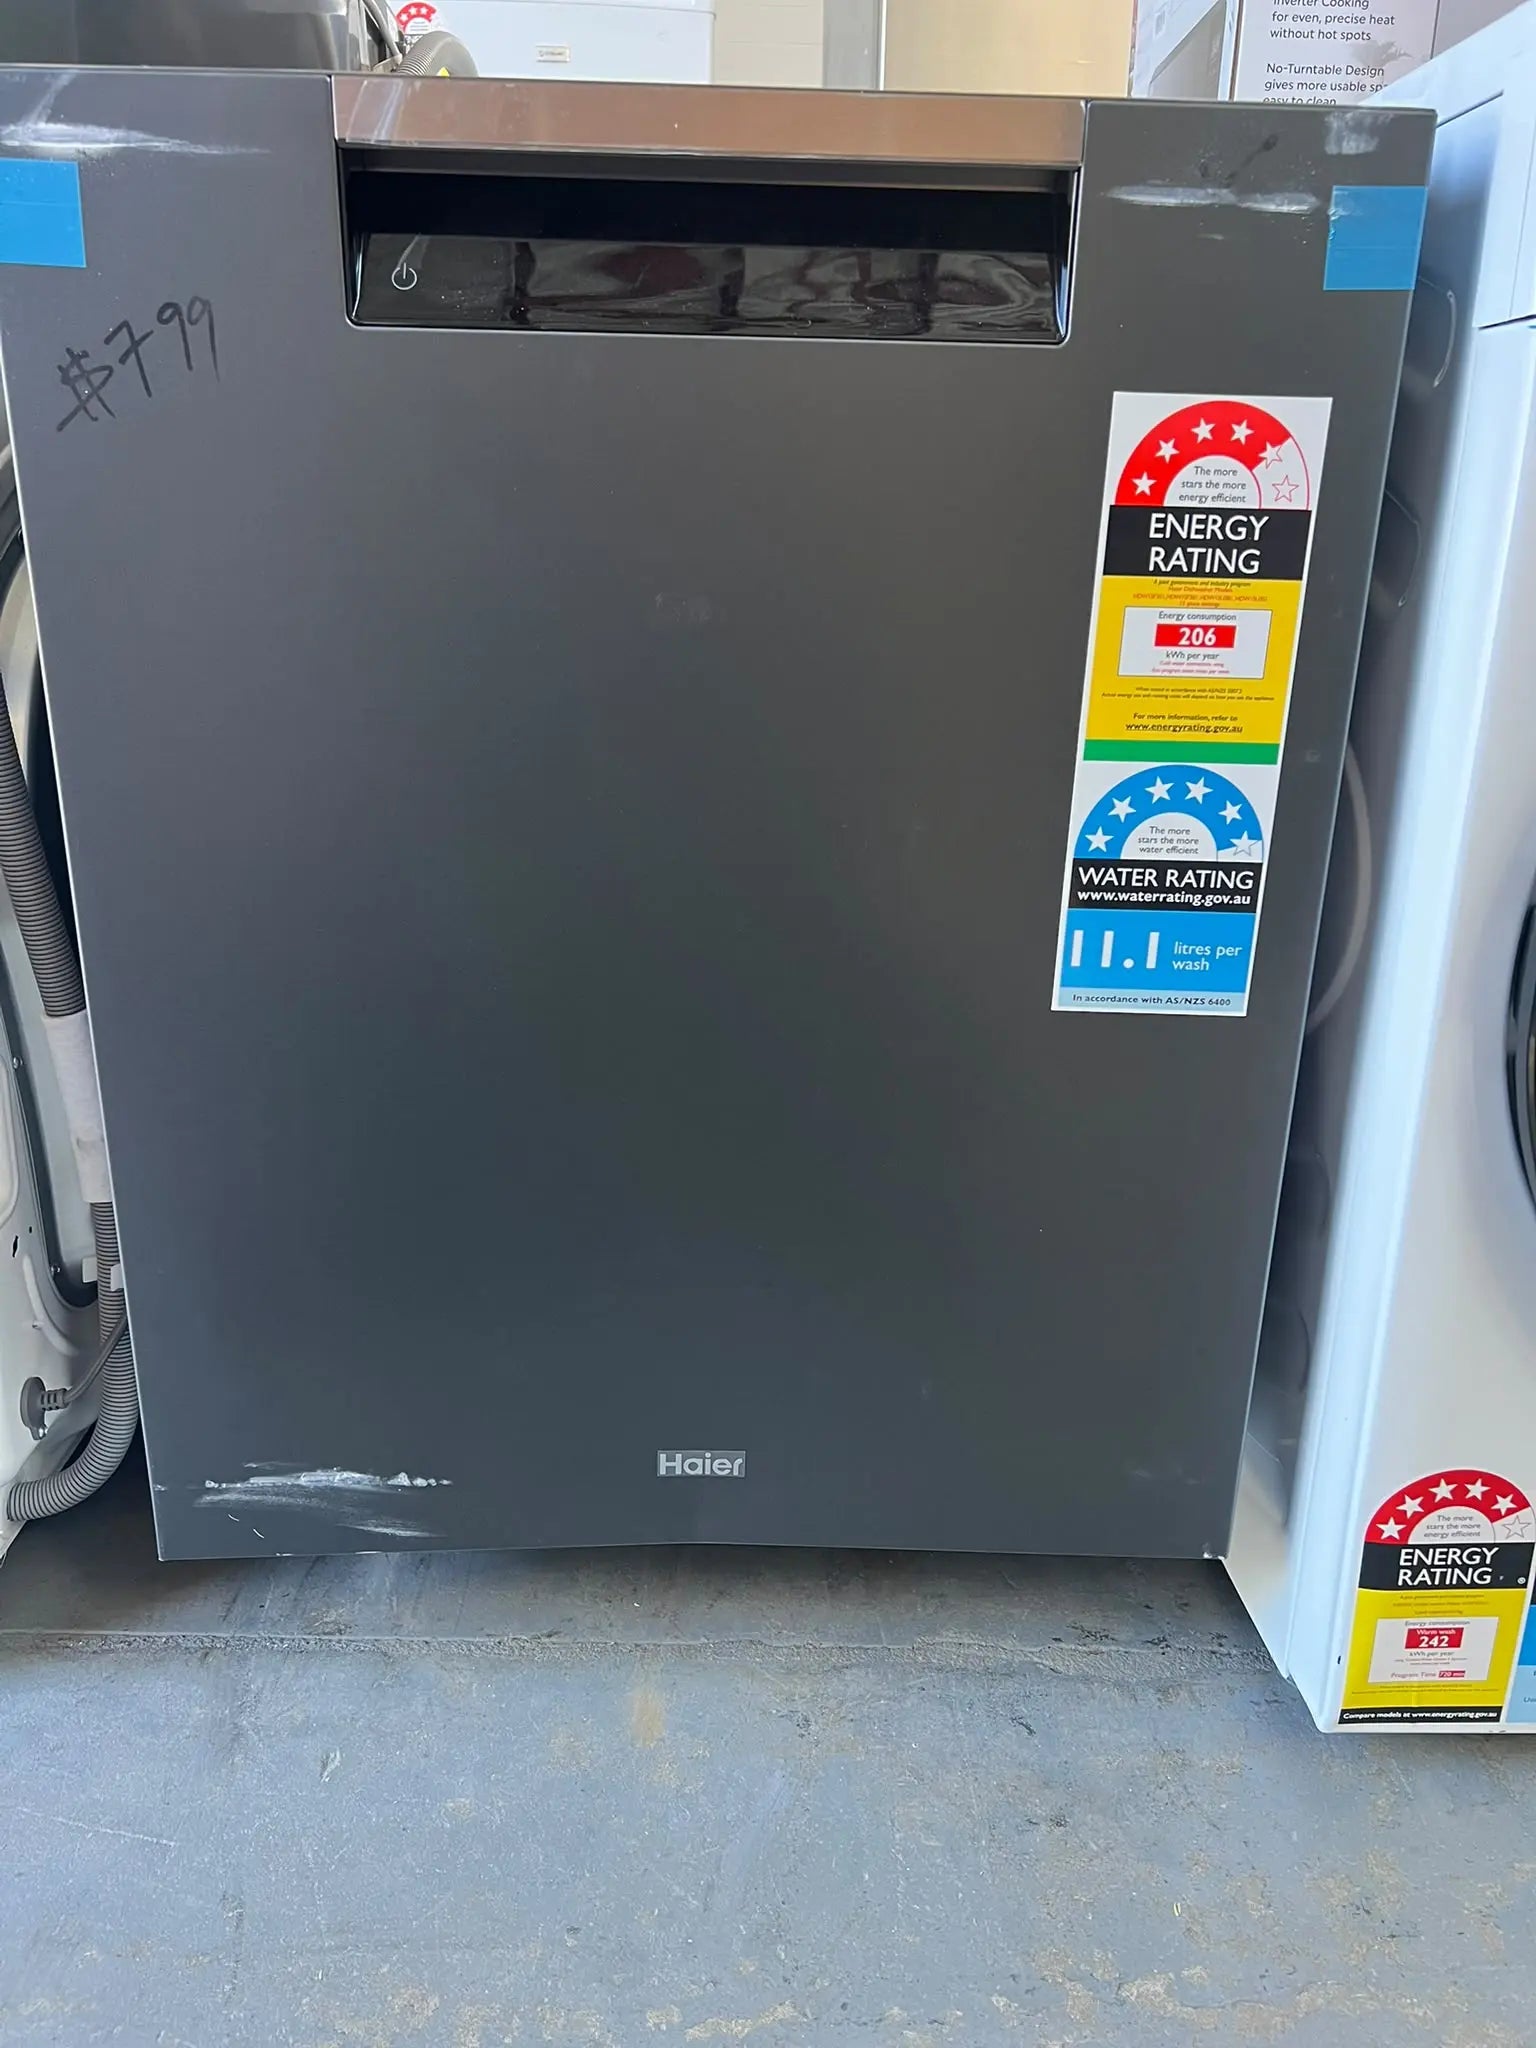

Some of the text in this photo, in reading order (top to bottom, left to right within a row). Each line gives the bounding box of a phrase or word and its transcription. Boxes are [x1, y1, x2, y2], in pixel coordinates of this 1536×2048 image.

[1322, 0, 1369, 10] Cooking
[1272, 11, 1395, 25] for even, precise heat
[1270, 28, 1371, 42] without hot spots
[1266, 63, 1385, 78] No-Turntable Design
[1264, 79, 1293, 91] gives
[1297, 82, 1327, 90] more
[1330, 80, 1366, 92] usable
[1292, 96, 1303, 104] to
[1306, 95, 1336, 105] clean
[57, 295, 219, 432] $799
[1194, 466, 1211, 476] The
[1181, 480, 1247, 490] stars the more
[1179, 493, 1247, 504] energy efficient
[1149, 513, 1269, 541] ENERGY
[1149, 547, 1261, 574] RATING
[1158, 611, 1236, 622] Energy consumption
[1178, 627, 1217, 646] 206
[1166, 651, 1219, 661] kWh per year
[1167, 713, 1210, 721] information,
[1125, 722, 1243, 733] www.energyrating.gov.au
[1149, 825, 1165, 834] The
[1160, 836, 1174, 844] the
[1166, 845, 1199, 854] efficient
[1078, 866, 1254, 890] WATER RATING
[1077, 889, 1251, 906] www.waterrating.gov.au
[1071, 929, 1242, 969] 11.1 litres per
[1173, 958, 1210, 971] wash
[1085, 994, 1138, 1003] accordance
[1141, 996, 1163, 1004] with
[1165, 997, 1205, 1005] AS/NZS
[1208, 998, 1231, 1006] 6400
[659, 1452, 743, 1475] Haier
[1399, 1547, 1499, 1566] ENERGY
[1398, 1567, 1492, 1586] RATING
[1419, 1636, 1449, 1648] 242
[1343, 1712, 1375, 1720] Compare
